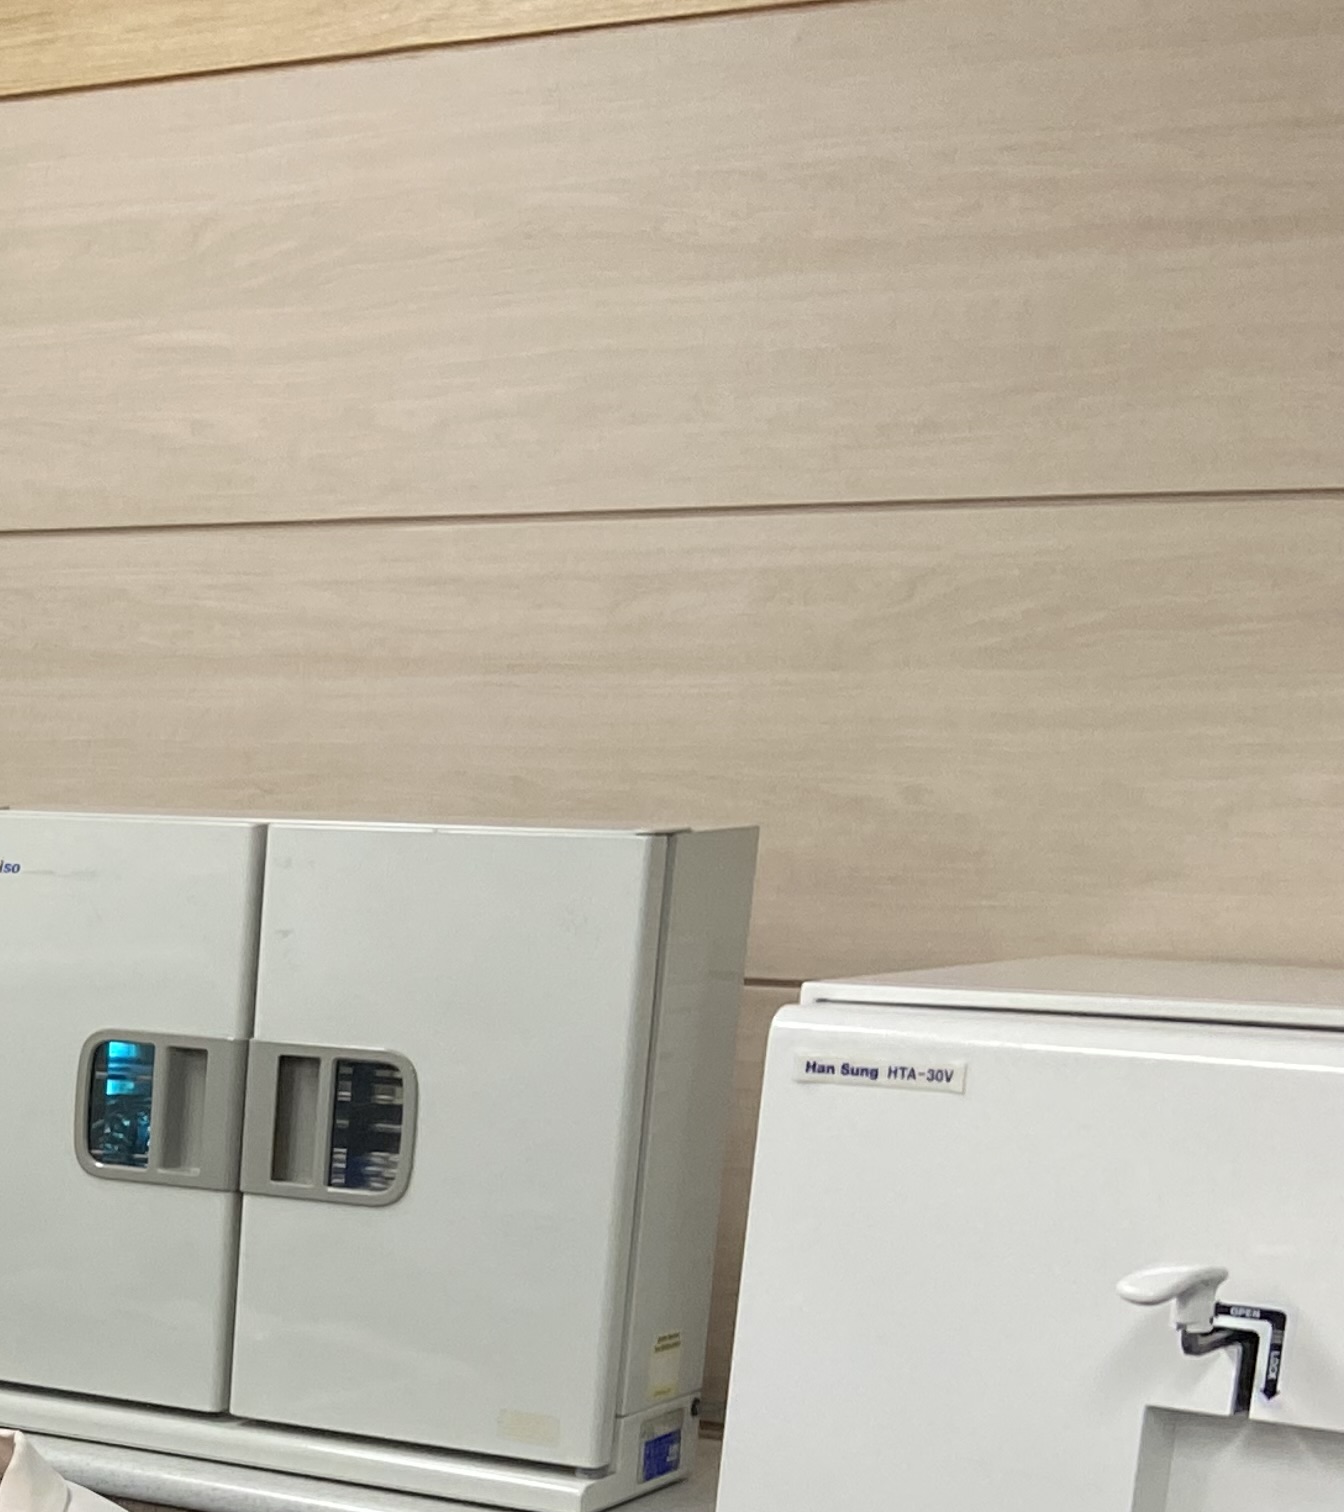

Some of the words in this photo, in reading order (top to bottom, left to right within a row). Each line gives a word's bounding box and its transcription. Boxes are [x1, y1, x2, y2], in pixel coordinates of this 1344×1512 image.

[804, 1060, 836, 1076] Han
[840, 1062, 879, 1080] Sung
[886, 1065, 954, 1083] HTA-30V
[1230, 1306, 1261, 1319] OPEN
[1267, 1350, 1281, 1380] LOCK
